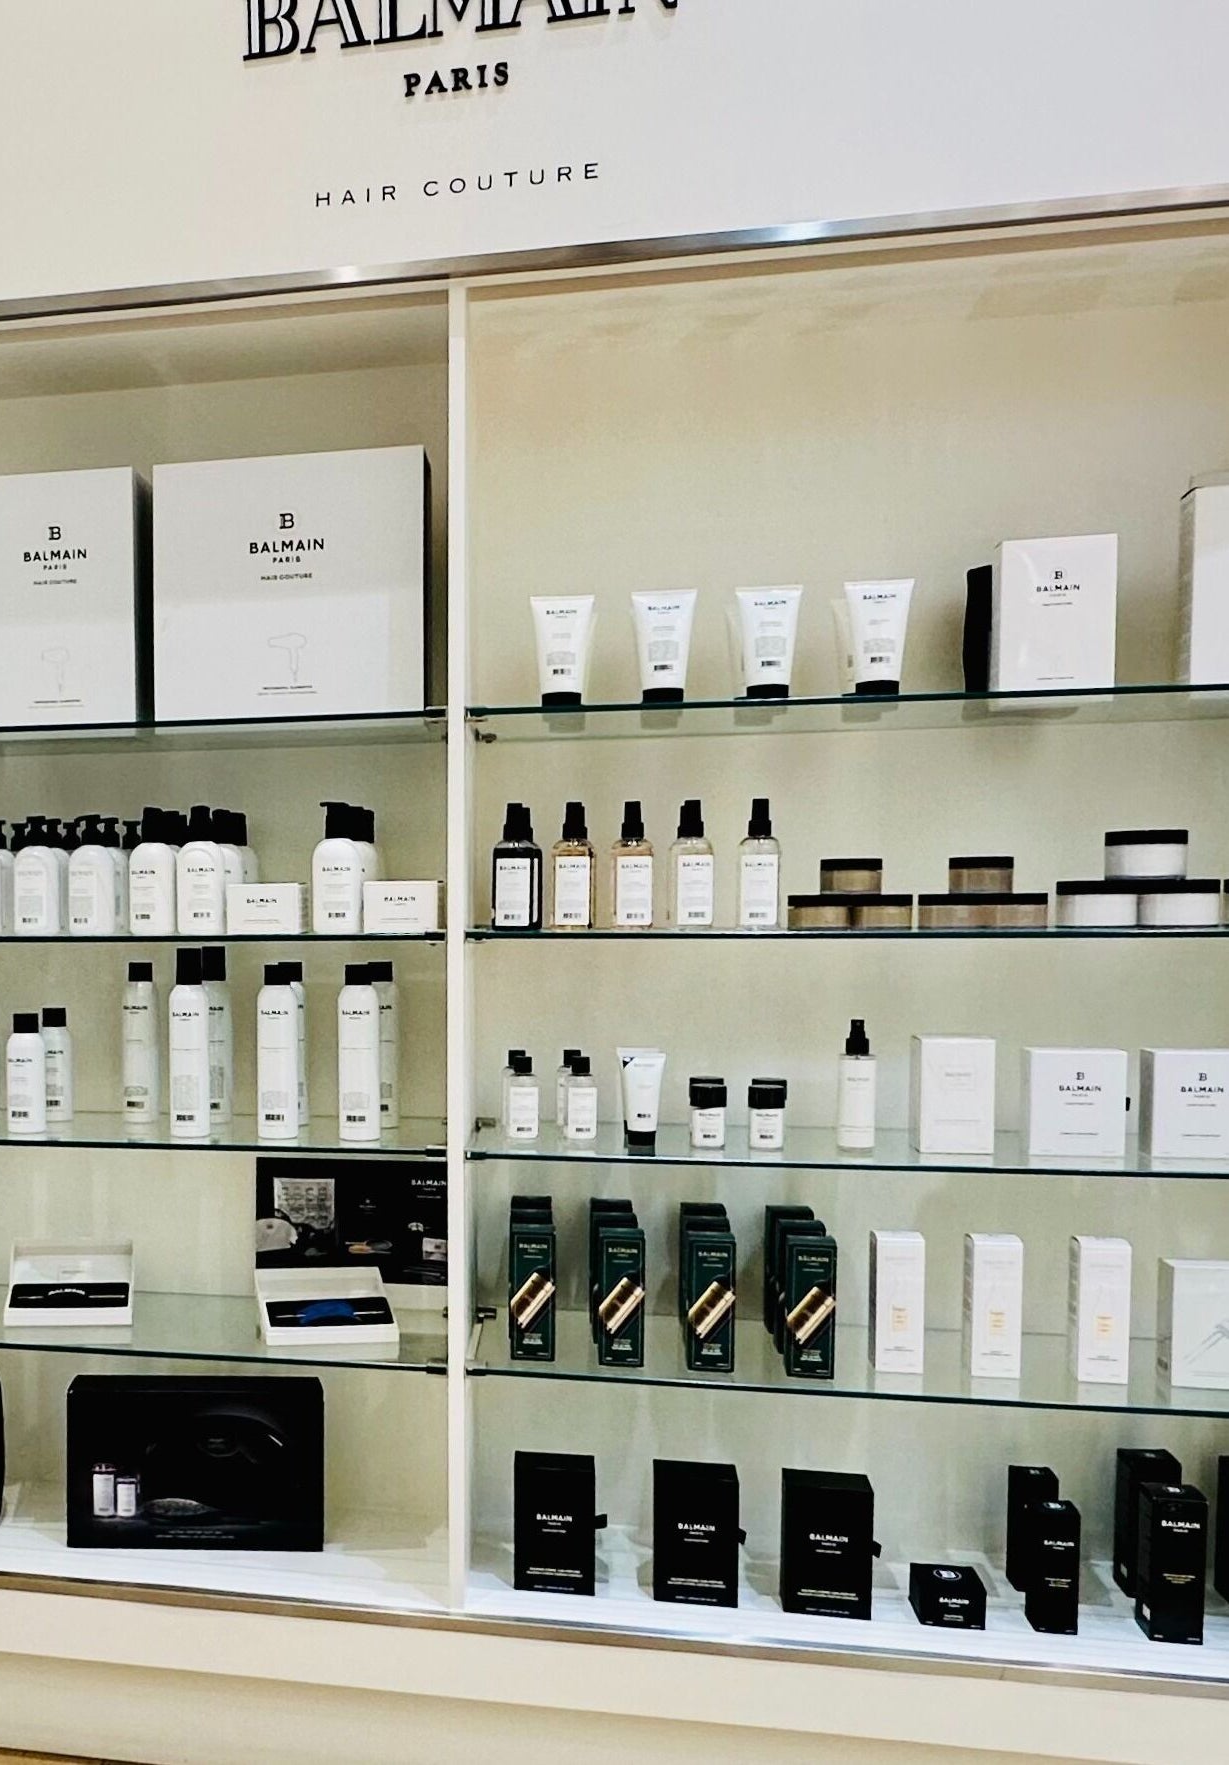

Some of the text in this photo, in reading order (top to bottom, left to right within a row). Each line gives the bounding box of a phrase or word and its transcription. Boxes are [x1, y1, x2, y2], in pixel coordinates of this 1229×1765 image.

[404, 61, 510, 97] PARIS
[316, 163, 599, 207] HAIR COUTURE
[279, 513, 294, 529] B
[49, 526, 61, 540] B
[250, 539, 324, 553] BALMAIN
[24, 550, 86, 562] BALMAIN
[273, 556, 300, 564] PARIS
[1037, 584, 1079, 592] BALMAIN
[536, 1513, 573, 1522] BALMAIN
[677, 1522, 716, 1532] BALMAIN
[1161, 1519, 1201, 1530] BALMAIN
[809, 1533, 849, 1543] BALMAIN
